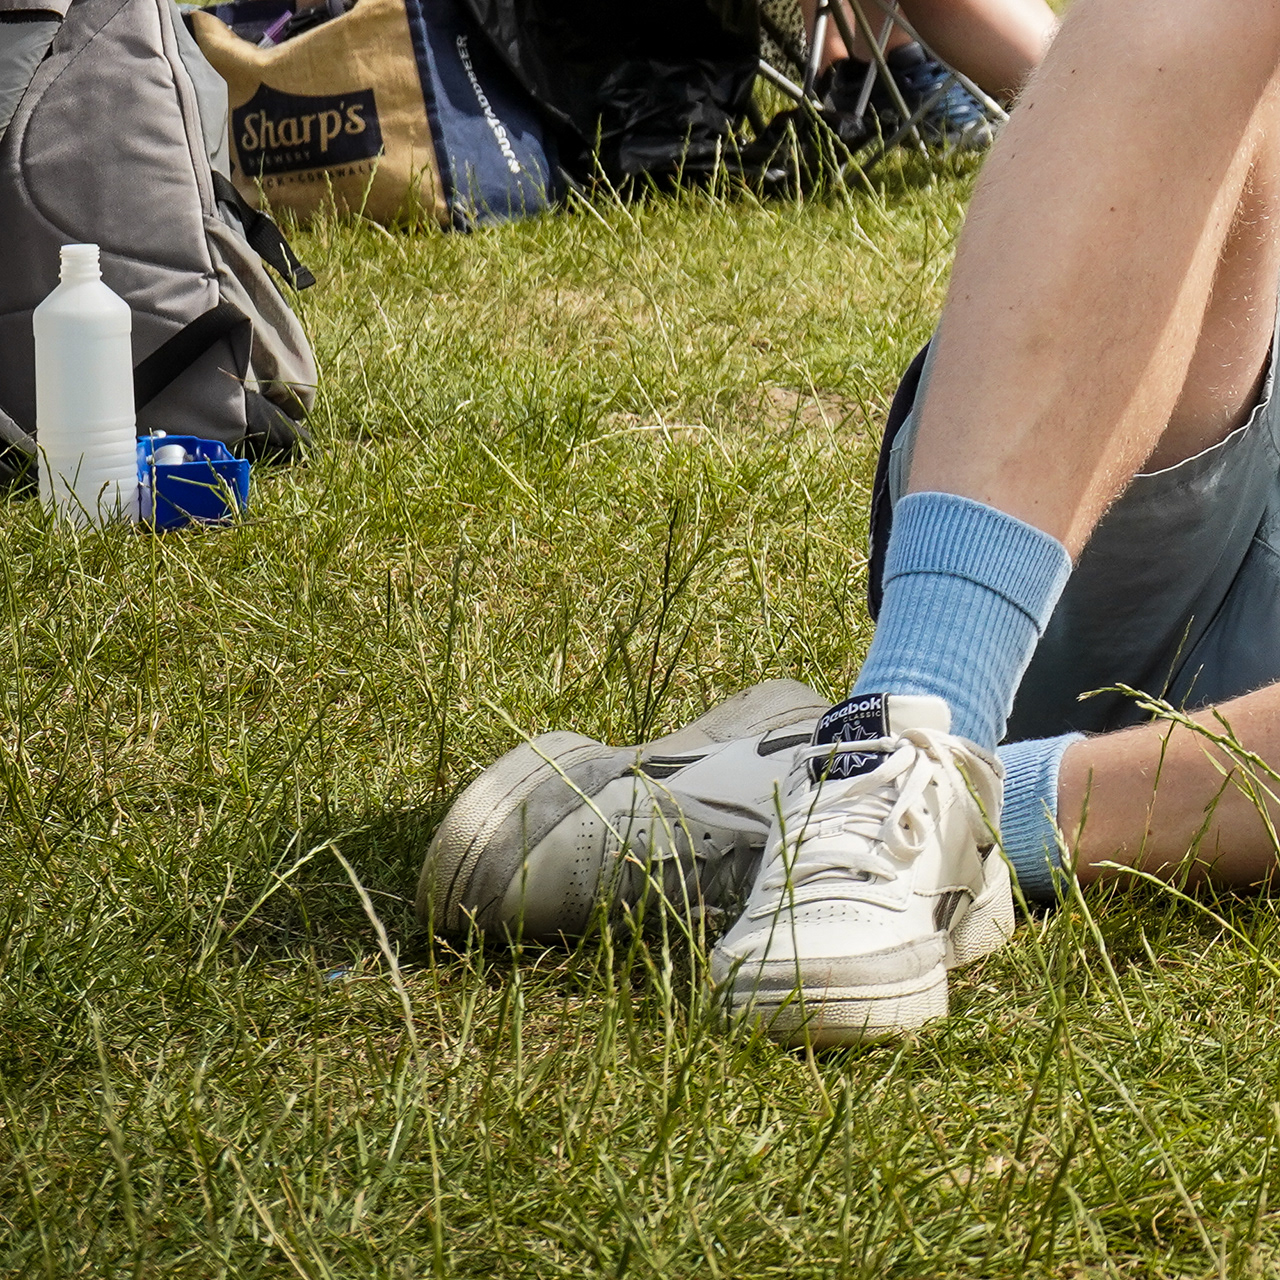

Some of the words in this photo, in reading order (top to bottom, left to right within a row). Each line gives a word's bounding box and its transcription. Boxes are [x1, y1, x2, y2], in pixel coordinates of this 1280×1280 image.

[241, 100, 367, 153] Sharp's
[820, 697, 882, 729] Reebok
[843, 710, 882, 723] CLASSIC
